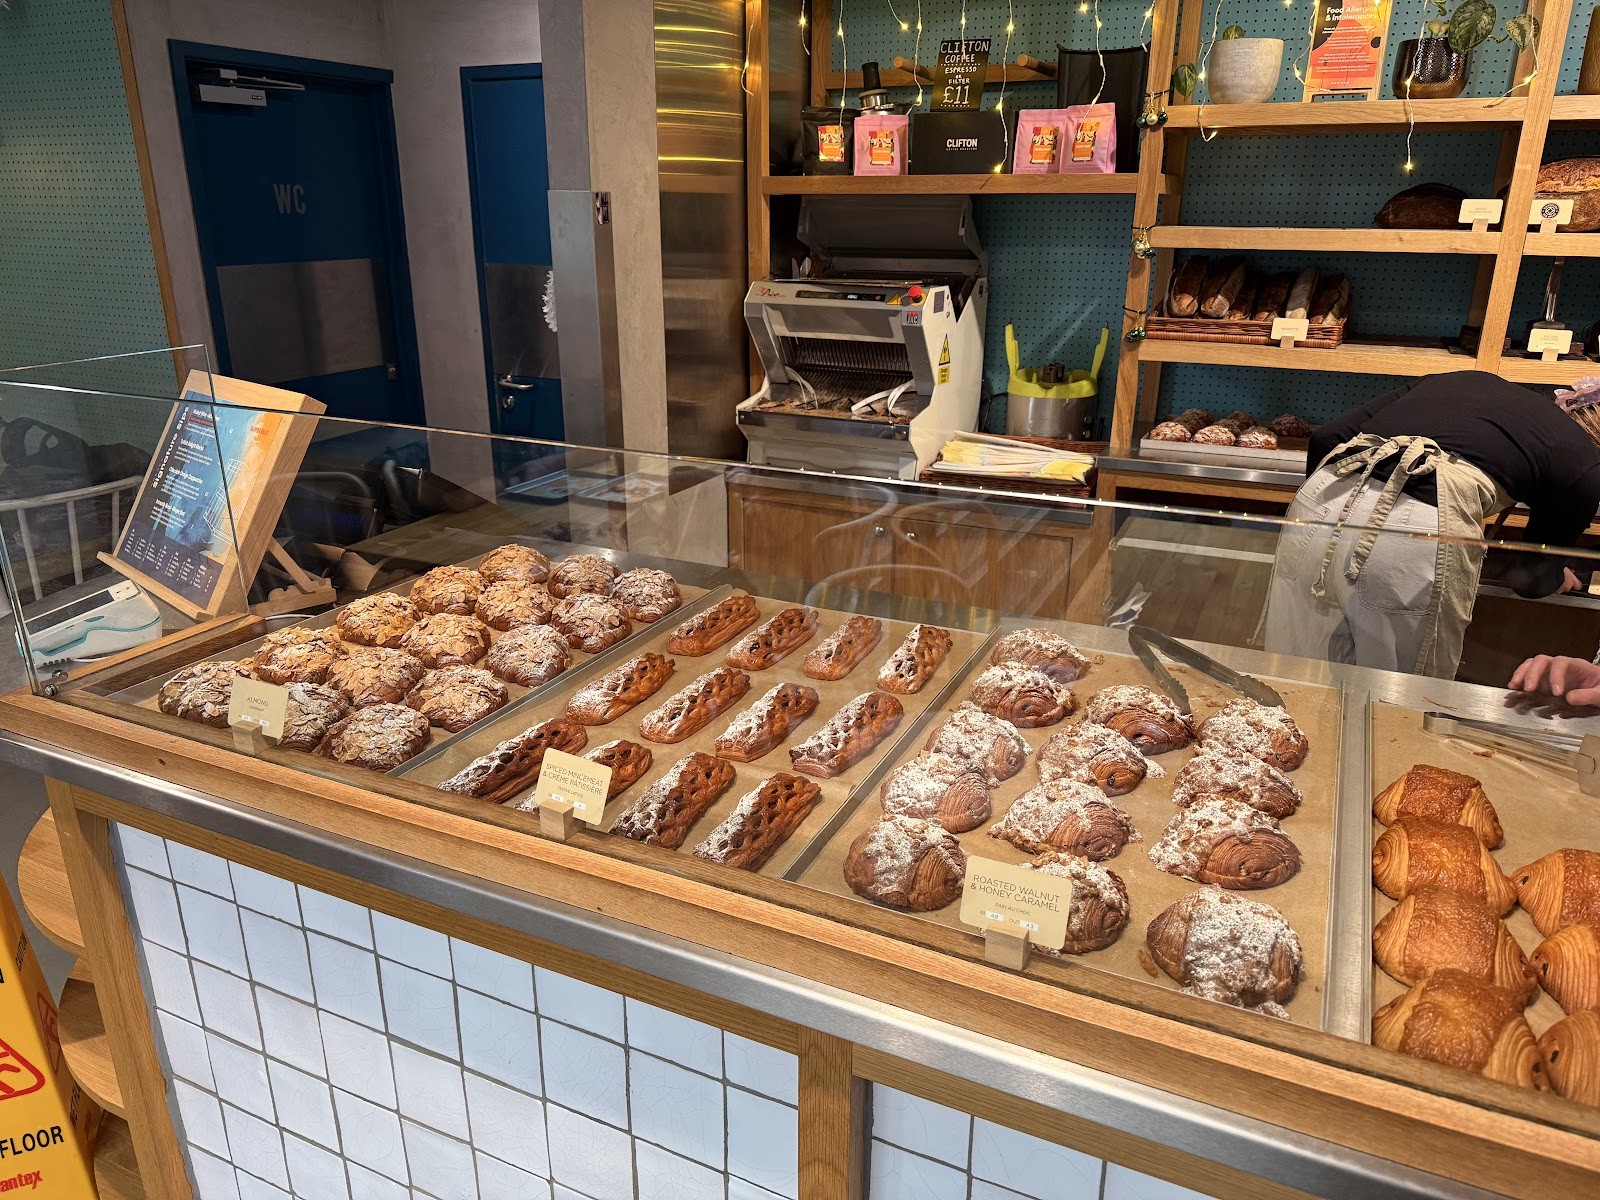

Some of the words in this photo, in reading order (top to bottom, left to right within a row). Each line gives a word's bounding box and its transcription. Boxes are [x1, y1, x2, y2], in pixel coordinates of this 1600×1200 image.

[1345, 5, 1378, 13] Allergies
[1332, 13, 1377, 21] Intolerances
[941, 41, 989, 53] CLIFTON
[944, 54, 975, 63] COFFEE
[945, 66, 977, 74] ESPRESSO
[943, 85, 969, 104] £11
[946, 138, 978, 148] CLIFTON
[273, 183, 306, 215] WC
[247, 697, 268, 706] ALMOND
[546, 764, 567, 775] SPICED
[568, 771, 603, 786] MINCEMEAT
[973, 874, 1017, 892] ROASTED
[1019, 886, 1061, 903] WALNUT
[970, 882, 977, 890] &
[979, 884, 1012, 899] HONEY
[1014, 894, 1060, 913] CARAMEL
[1015, 908, 1031, 916] CHOC
[0, 1125, 64, 1159] FLOOR
